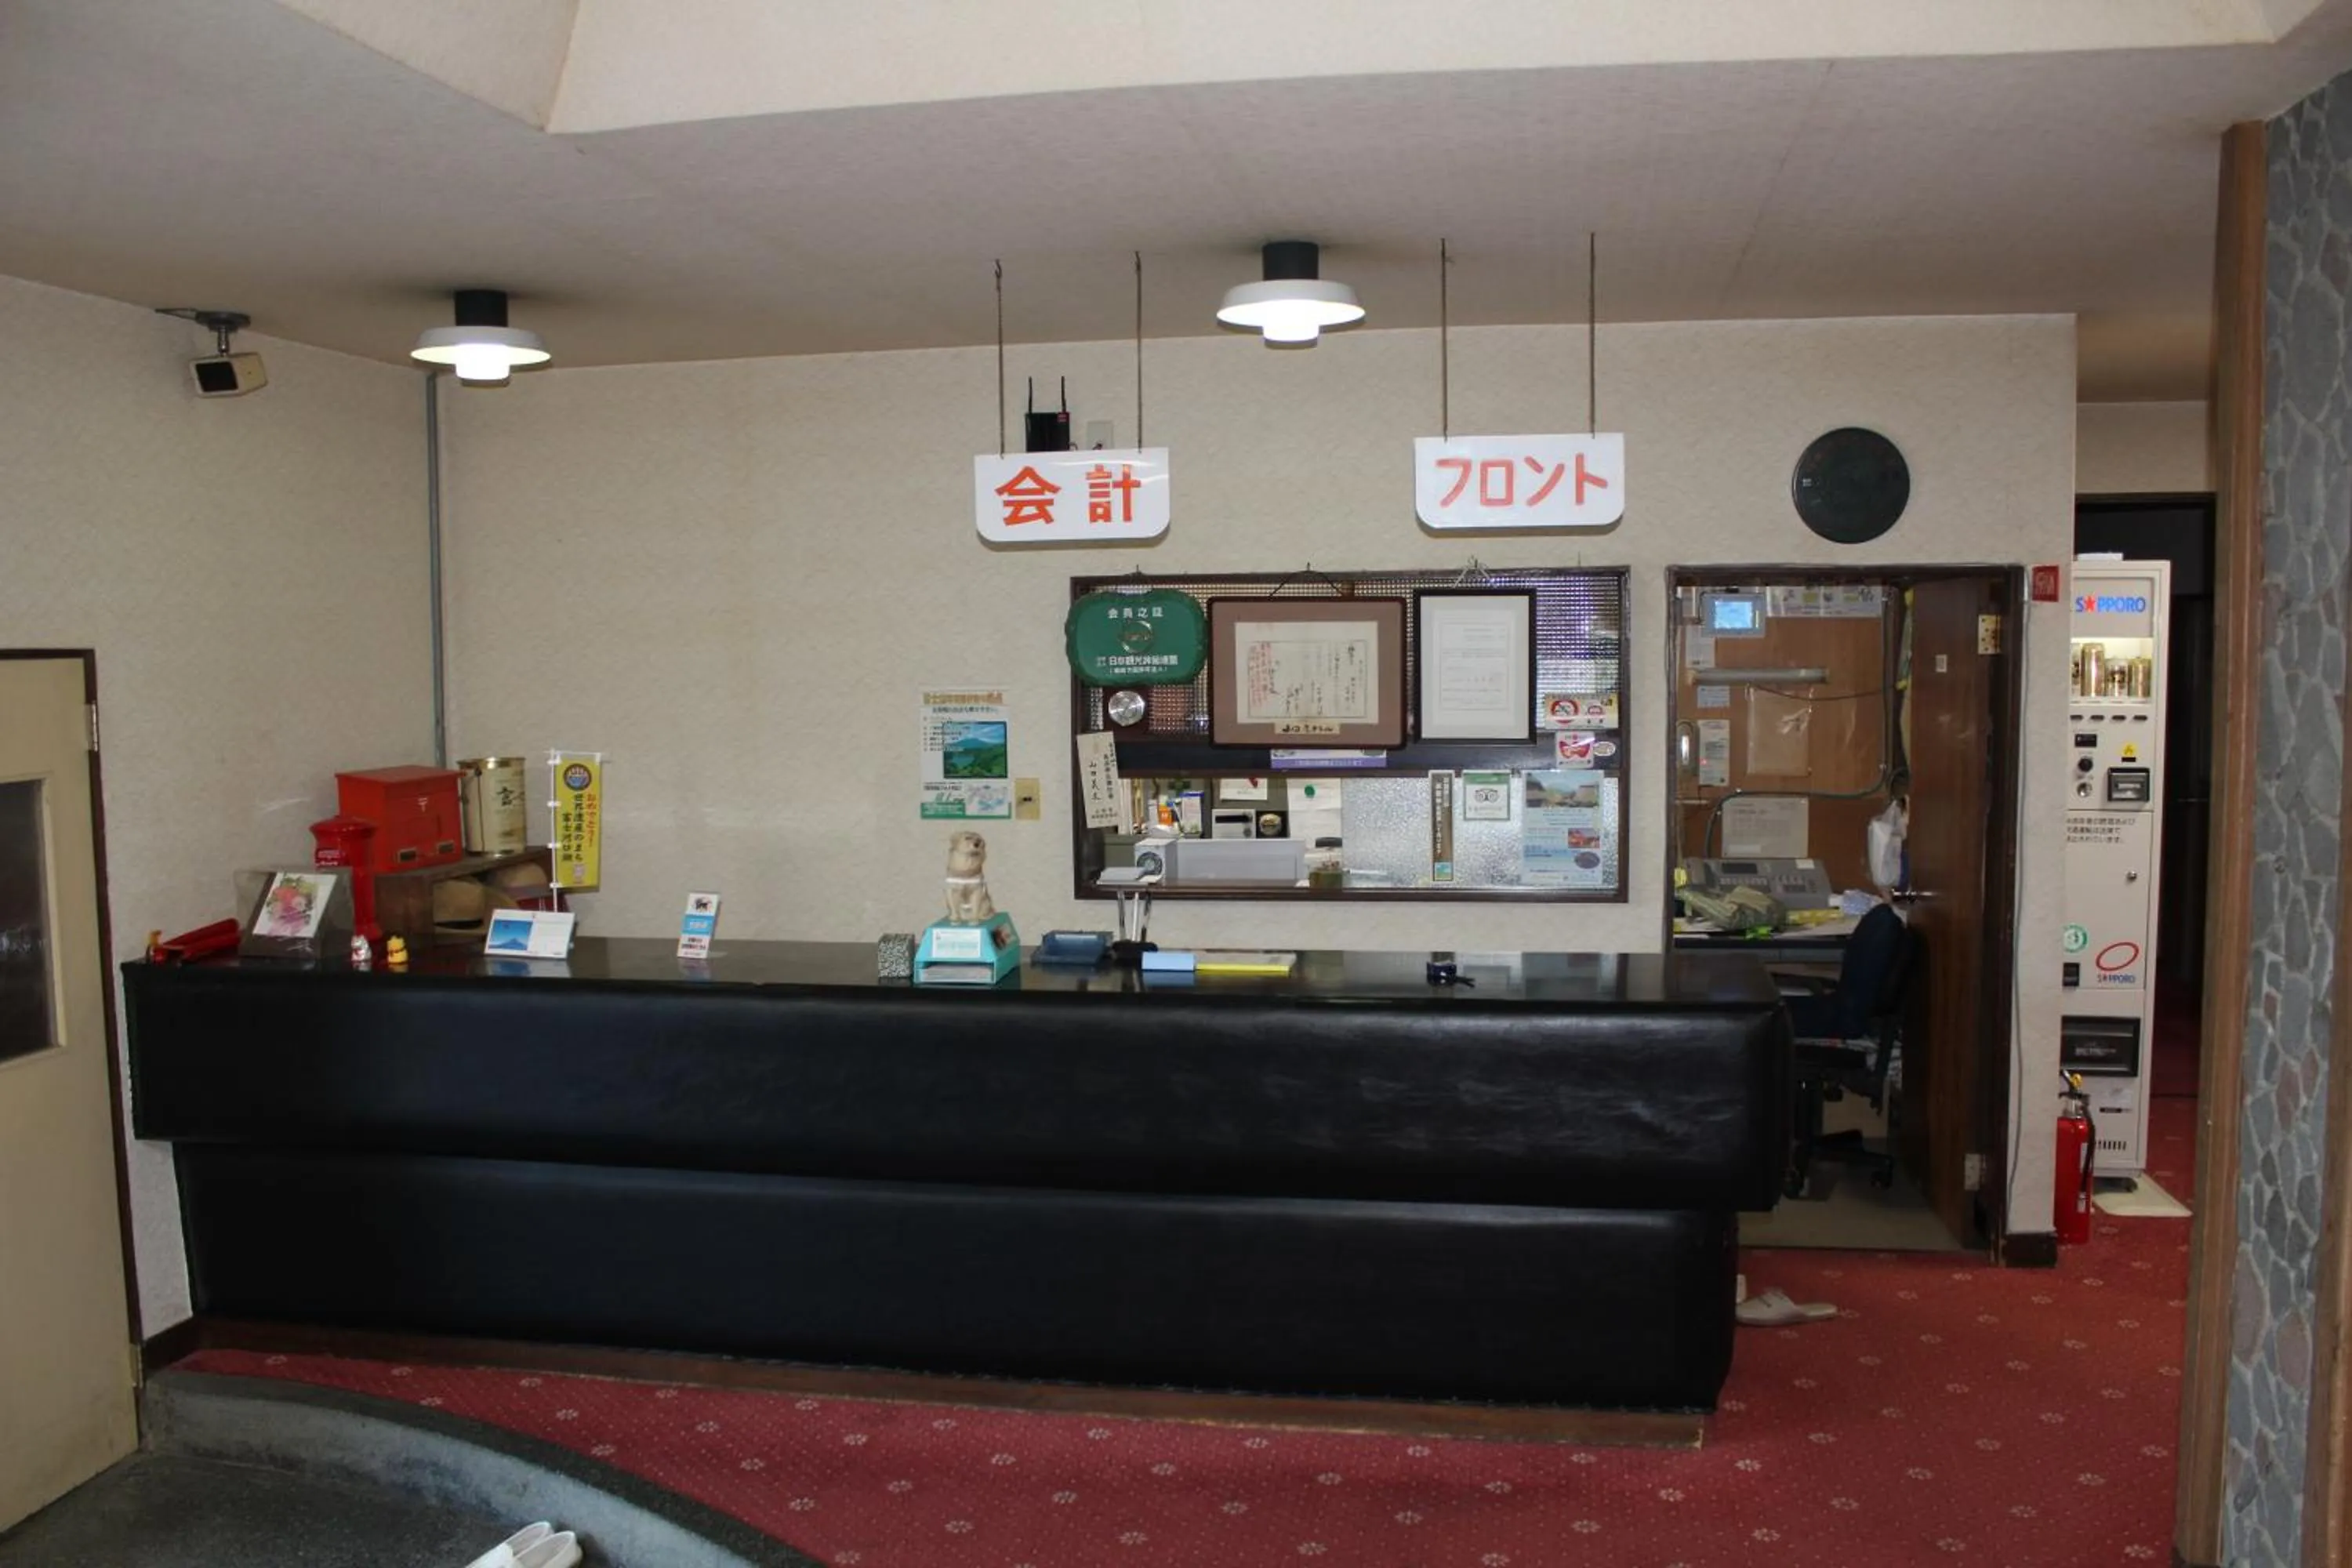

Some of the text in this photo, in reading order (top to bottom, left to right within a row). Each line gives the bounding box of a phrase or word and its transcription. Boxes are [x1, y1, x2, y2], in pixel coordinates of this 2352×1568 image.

[995, 464, 1142, 526] 会計
[1436, 452, 1608, 508] フロント
